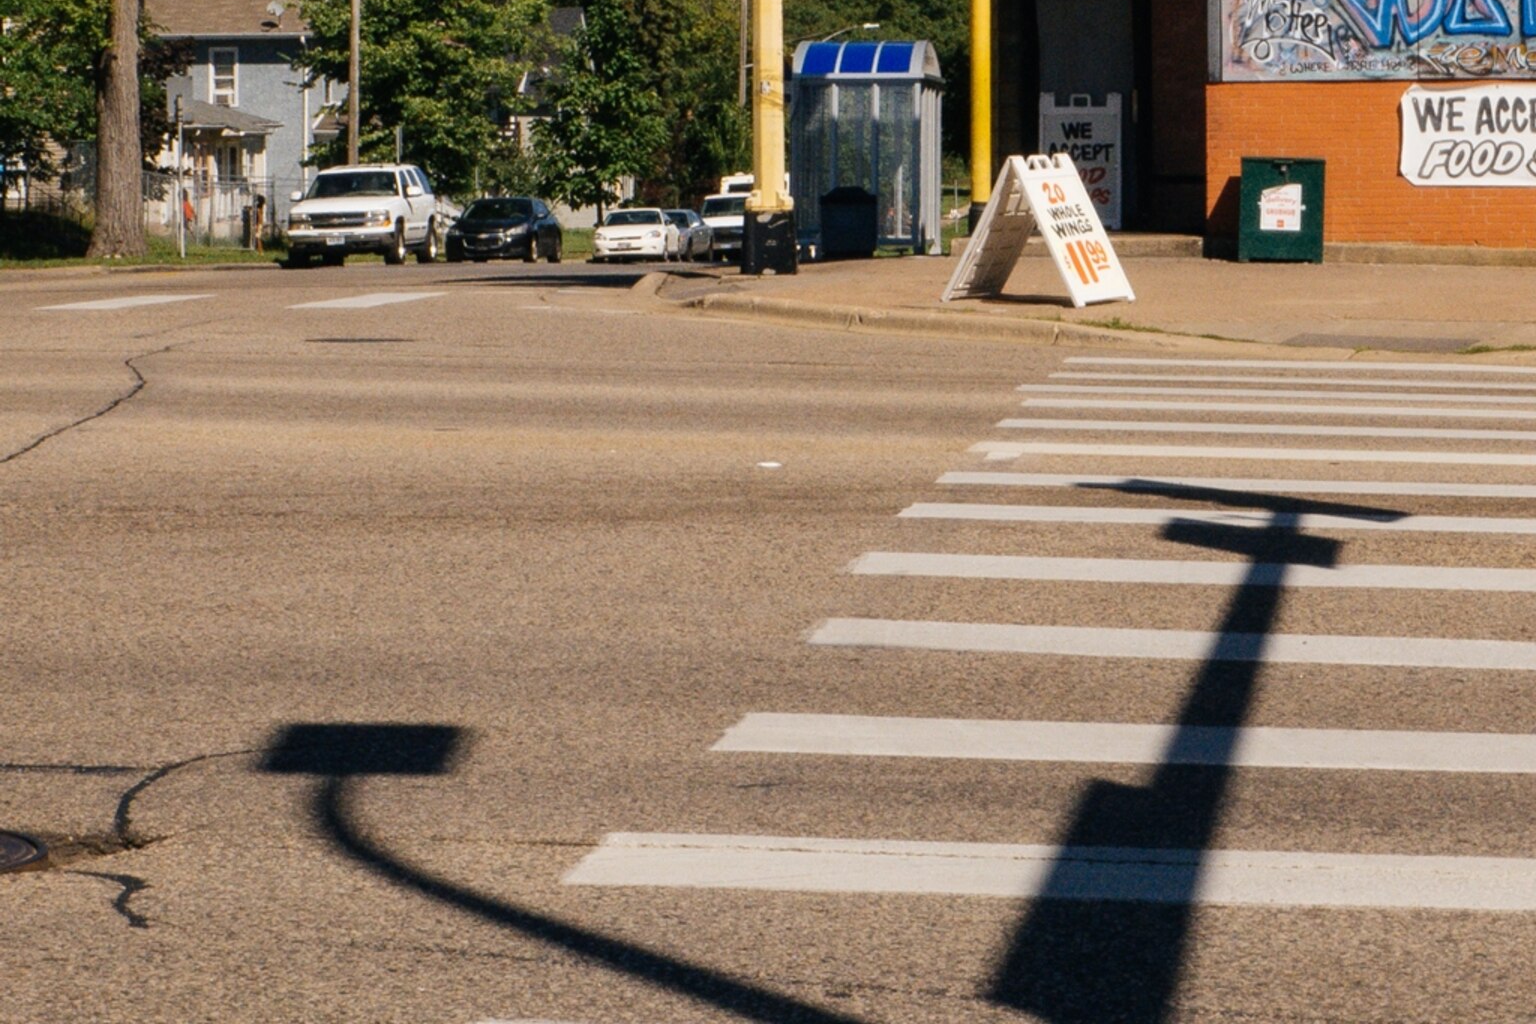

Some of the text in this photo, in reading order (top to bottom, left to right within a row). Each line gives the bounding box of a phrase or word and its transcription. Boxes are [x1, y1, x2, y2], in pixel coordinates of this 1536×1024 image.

[1412, 96, 1466, 134] WE
[1061, 122, 1093, 140] WE
[1418, 140, 1527, 179] FOOD
[1041, 181, 1066, 204] 20
[1047, 203, 1086, 221] WHOLE
[1051, 218, 1093, 239] WINGS
